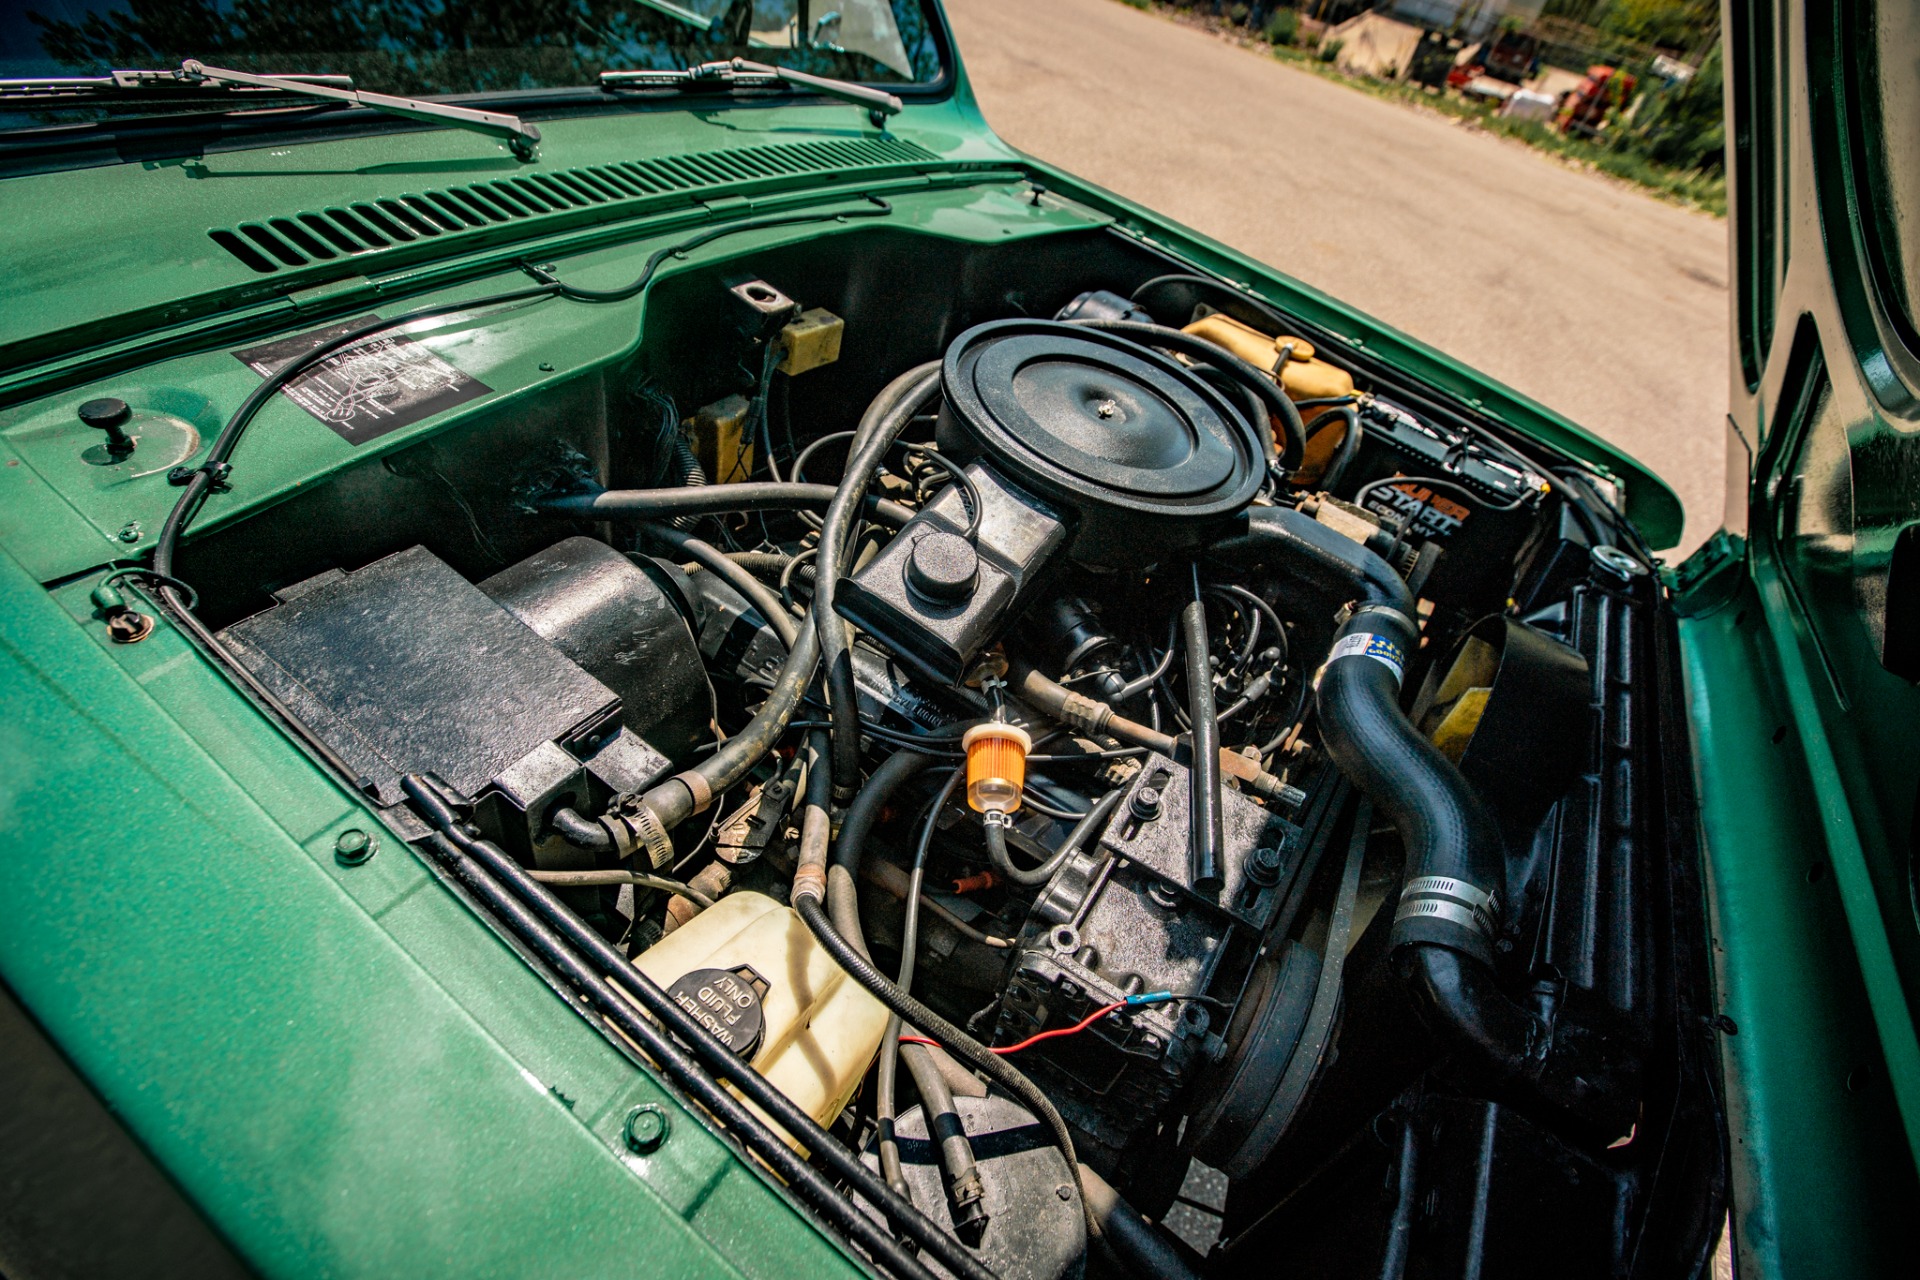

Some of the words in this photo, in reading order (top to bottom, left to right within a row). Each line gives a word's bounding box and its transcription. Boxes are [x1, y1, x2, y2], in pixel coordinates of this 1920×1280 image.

[1367, 500, 1437, 537] ECONMY
[1370, 485, 1464, 532] START
[697, 986, 742, 1027] FLUID
[713, 976, 752, 1008] ONLY
[673, 990, 735, 1046] WASHER
